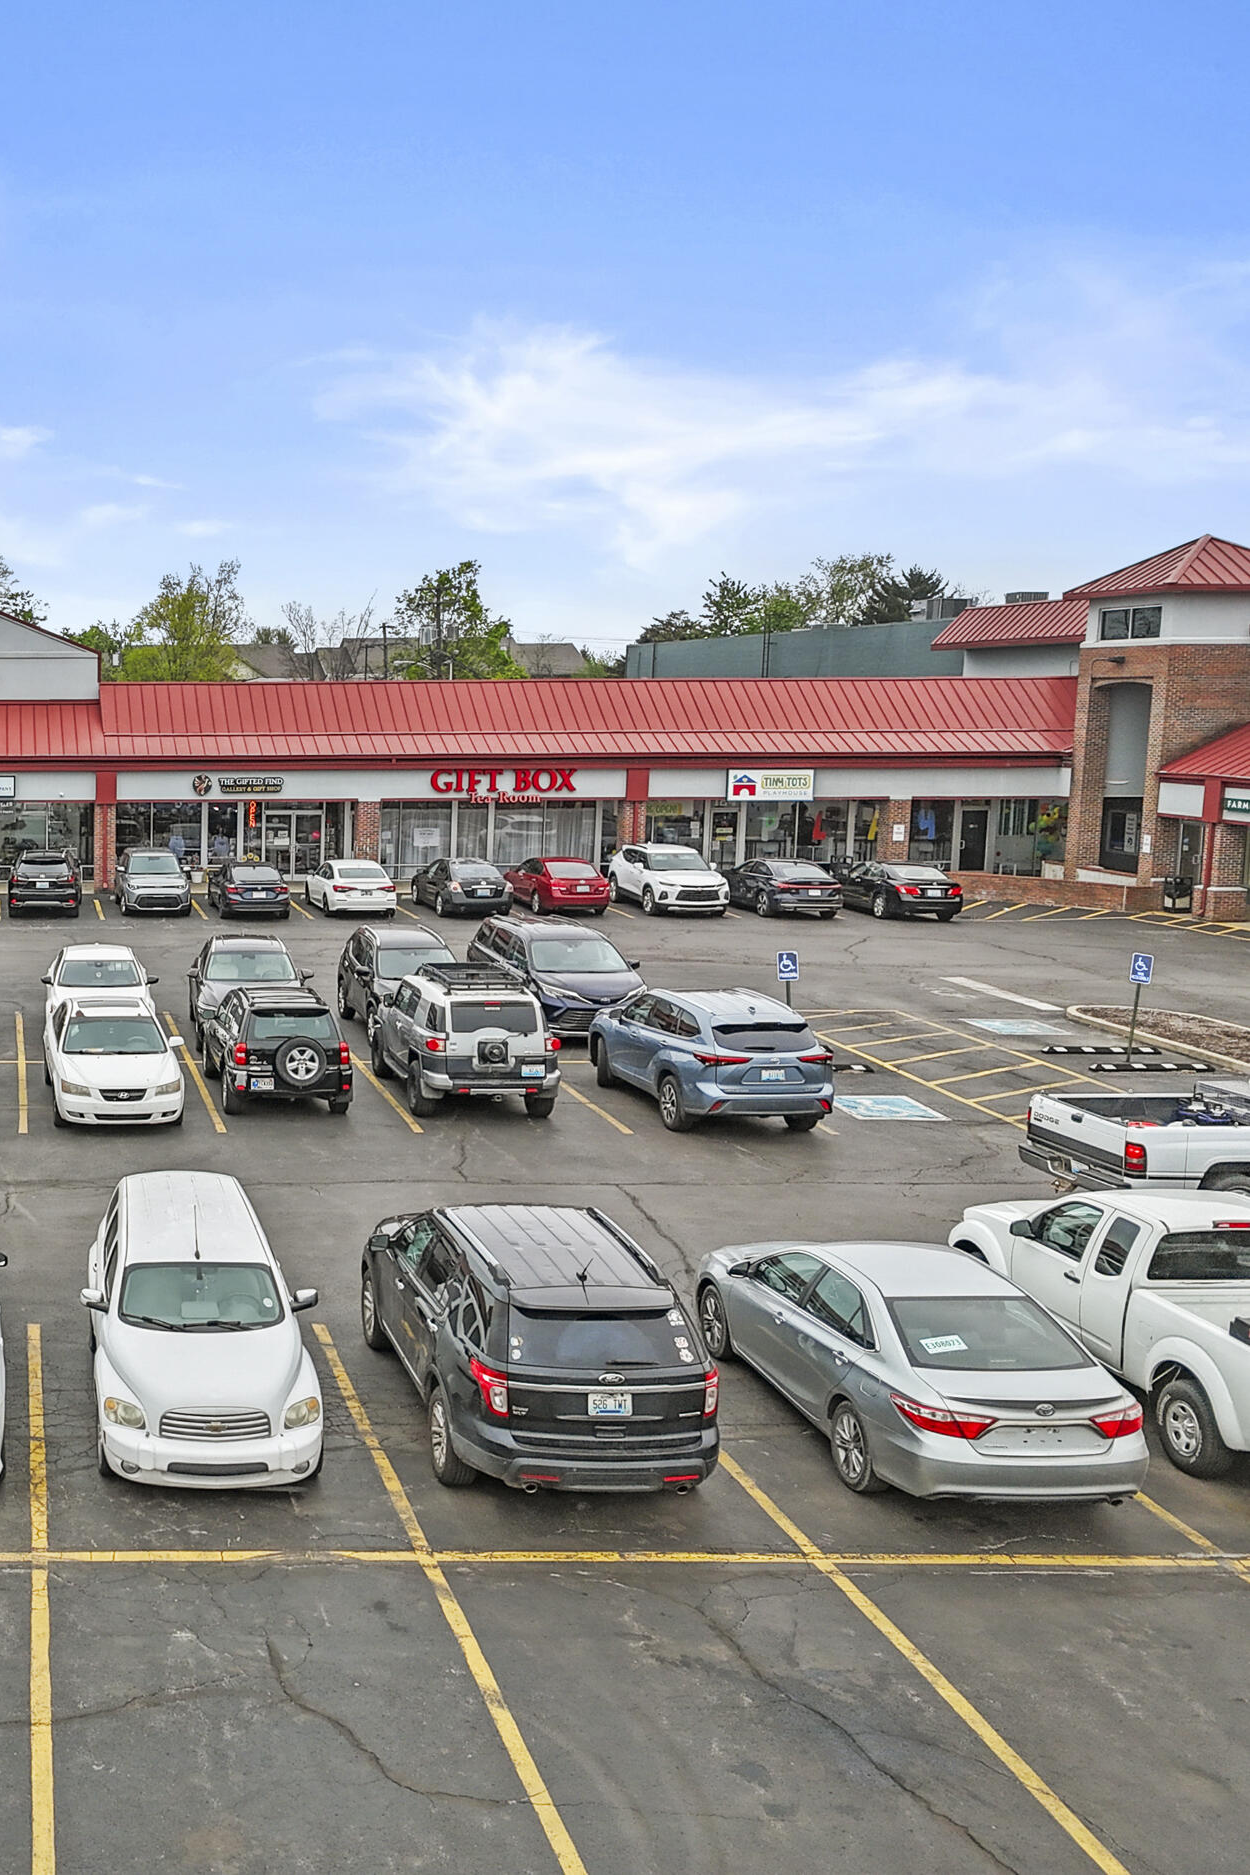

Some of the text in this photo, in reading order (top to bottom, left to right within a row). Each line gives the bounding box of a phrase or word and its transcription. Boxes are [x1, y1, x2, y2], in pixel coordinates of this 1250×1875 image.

[430, 769, 578, 793] GIFT BOX
[763, 777, 808, 787] TINY TOTS
[468, 791, 541, 804] Tea Room
[1227, 799, 1249, 810] FARM
[249, 801, 257, 828] OPEN
[1033, 1111, 1060, 1125] DODGE
[592, 1399, 627, 1410] 526 TWT
